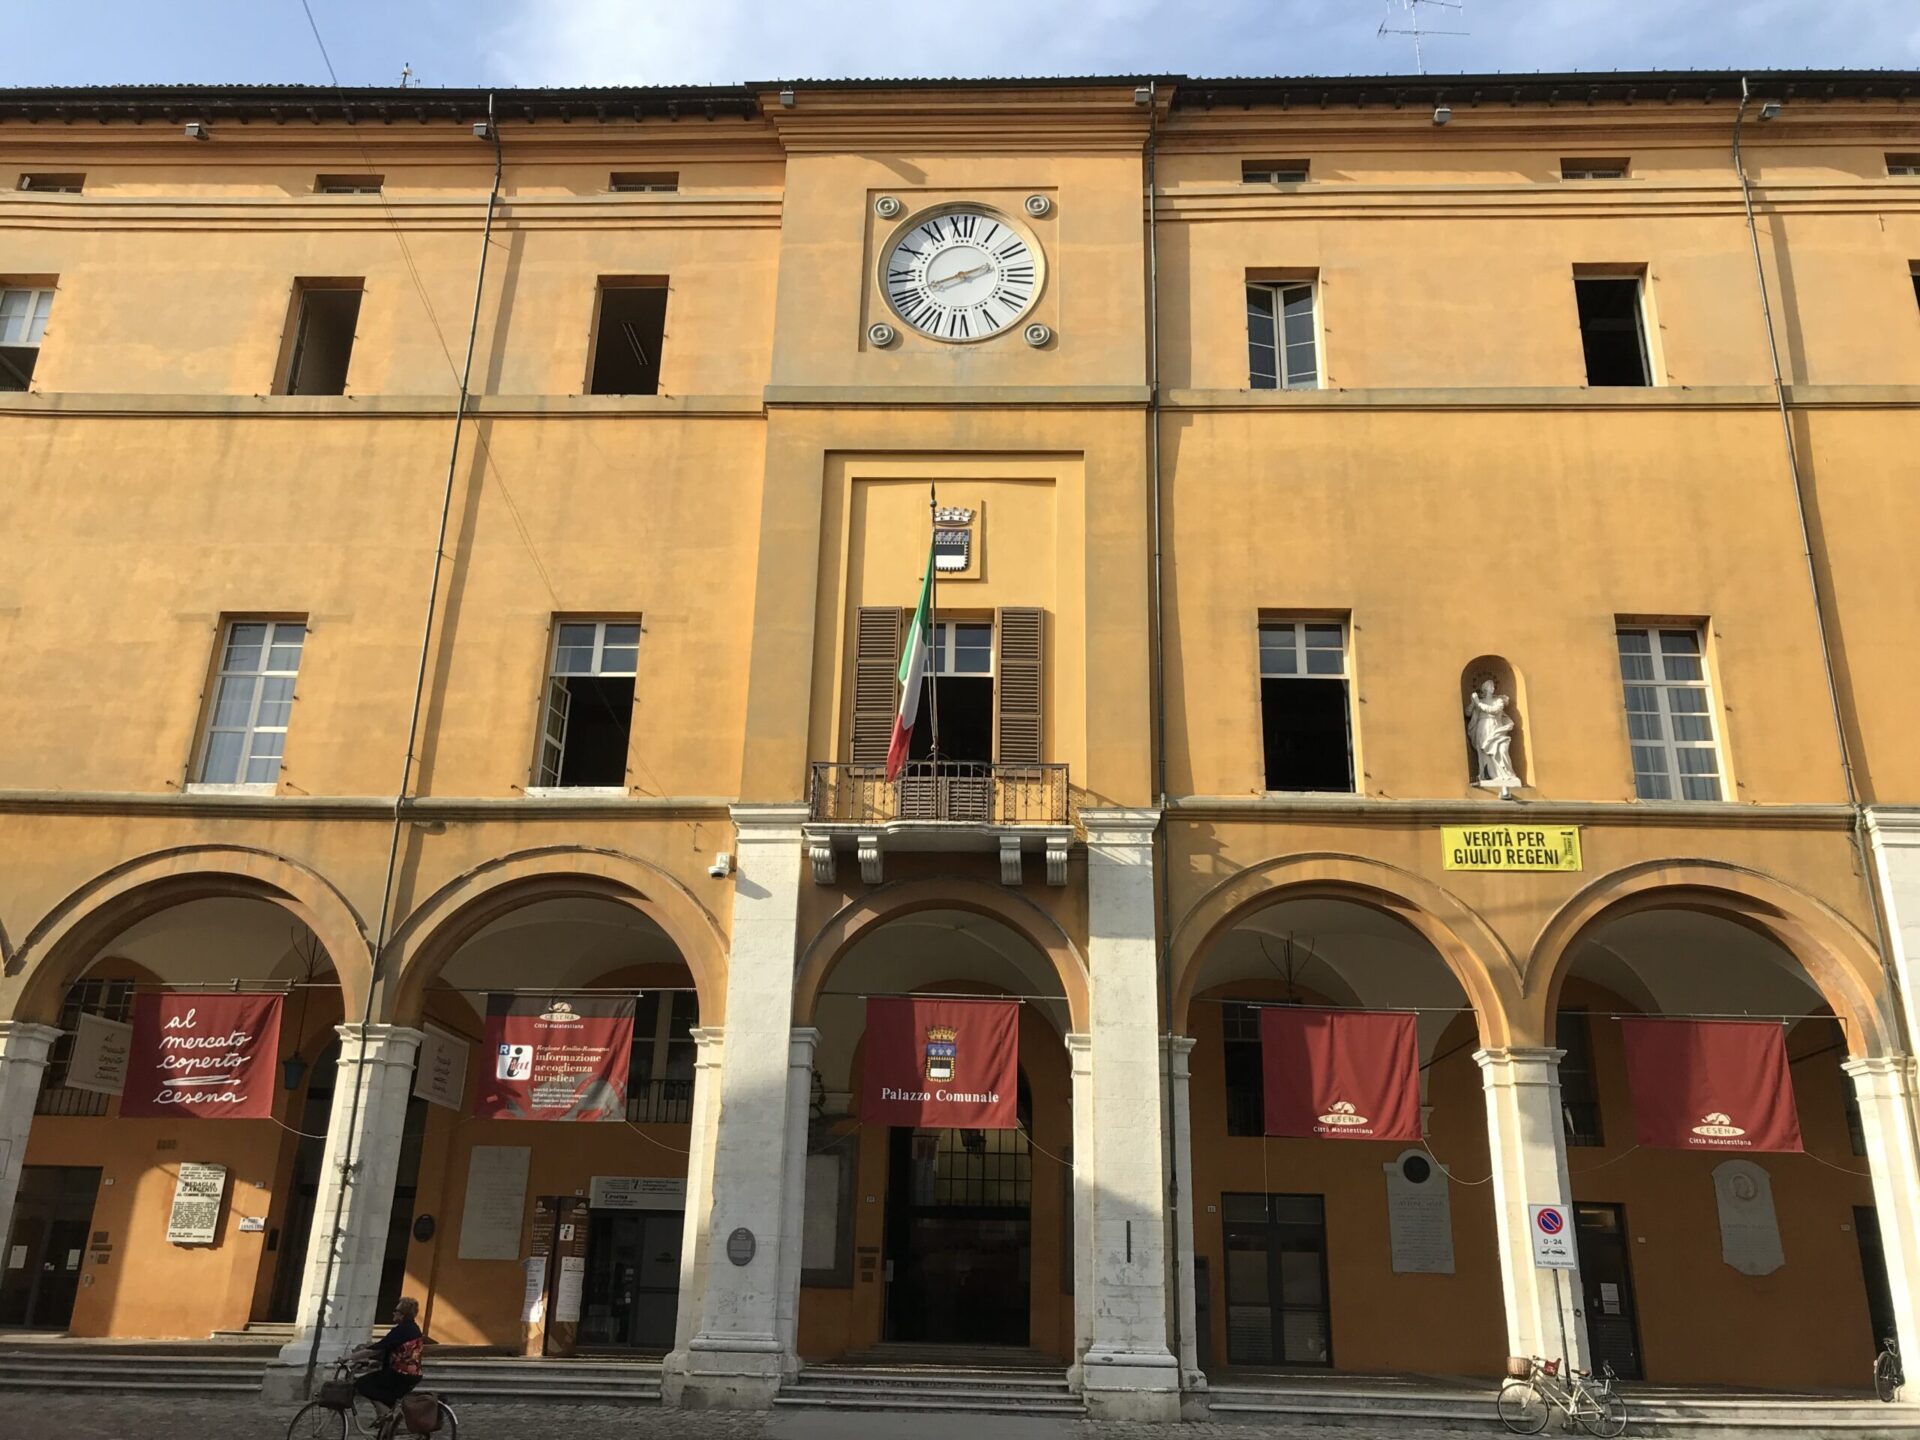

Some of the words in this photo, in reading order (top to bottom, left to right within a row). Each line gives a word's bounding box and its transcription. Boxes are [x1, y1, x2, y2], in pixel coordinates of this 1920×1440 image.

[920, 221, 945, 246] XI
[950, 216, 976, 238] XII
[984, 223, 999, 243] I
[898, 242, 924, 261] X
[999, 241, 1026, 260] II
[1007, 266, 1034, 284] III
[892, 288, 924, 317] VIII
[913, 306, 942, 334] VII
[950, 314, 969, 337] VI
[982, 309, 1000, 332] V
[1463, 828, 1513, 846] VERITÀ
[1517, 831, 1545, 847] PER
[1454, 849, 1502, 864] GIULIO
[1506, 849, 1559, 865] REGENI
[164, 1008, 197, 1030] al
[159, 1030, 253, 1049] mercato
[500, 1044, 509, 1054] R
[156, 1053, 251, 1075] coperto
[535, 1052, 601, 1062] informazione
[535, 1062, 593, 1073] accoglienza
[533, 1073, 575, 1082] turistica
[881, 1088, 931, 1101] Palazzo
[936, 1089, 1000, 1103] Comunale
[1708, 1138, 1752, 1146] Malatestiana
